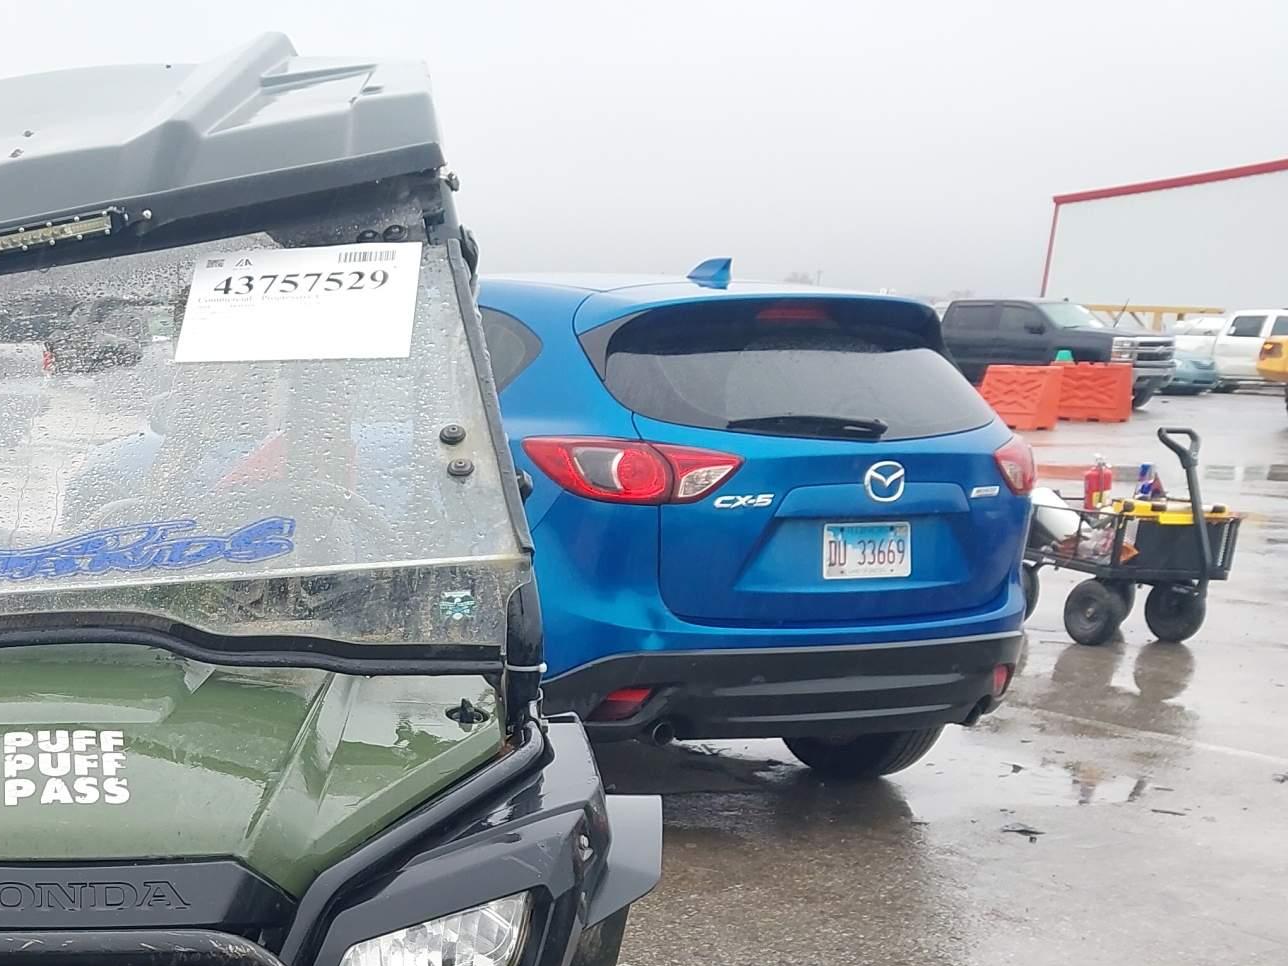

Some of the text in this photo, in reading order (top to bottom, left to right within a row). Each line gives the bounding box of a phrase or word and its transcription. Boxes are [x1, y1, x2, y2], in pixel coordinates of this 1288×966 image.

[213, 269, 389, 295] 43757529
[713, 493, 775, 509] CX-5
[857, 538, 906, 566] 33669
[3, 729, 124, 754] PUFF
[4, 752, 127, 778] PUFF
[4, 776, 130, 806] PASS
